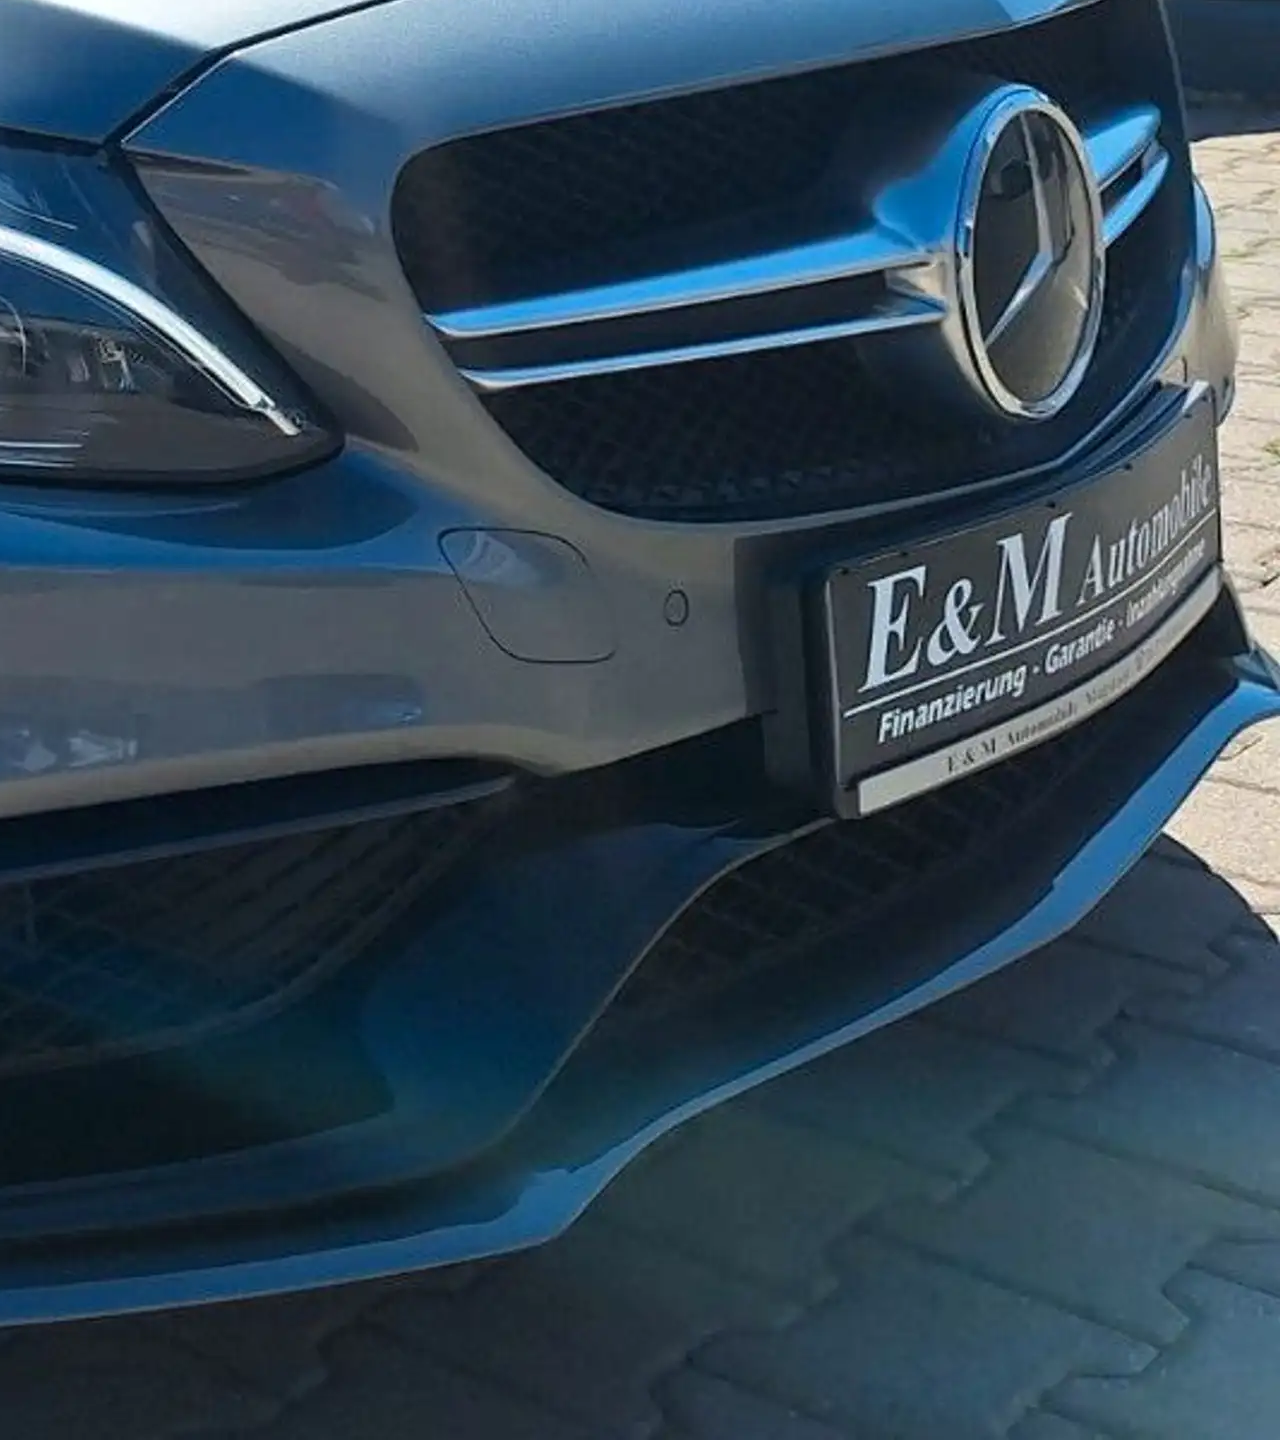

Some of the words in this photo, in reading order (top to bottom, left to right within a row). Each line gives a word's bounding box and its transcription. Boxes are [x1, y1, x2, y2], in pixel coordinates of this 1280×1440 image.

[857, 512, 1073, 693] E&M
[1075, 455, 1212, 607] Automobile
[877, 664, 1028, 744] Finanzierung
[1044, 617, 1116, 674] Garantie
